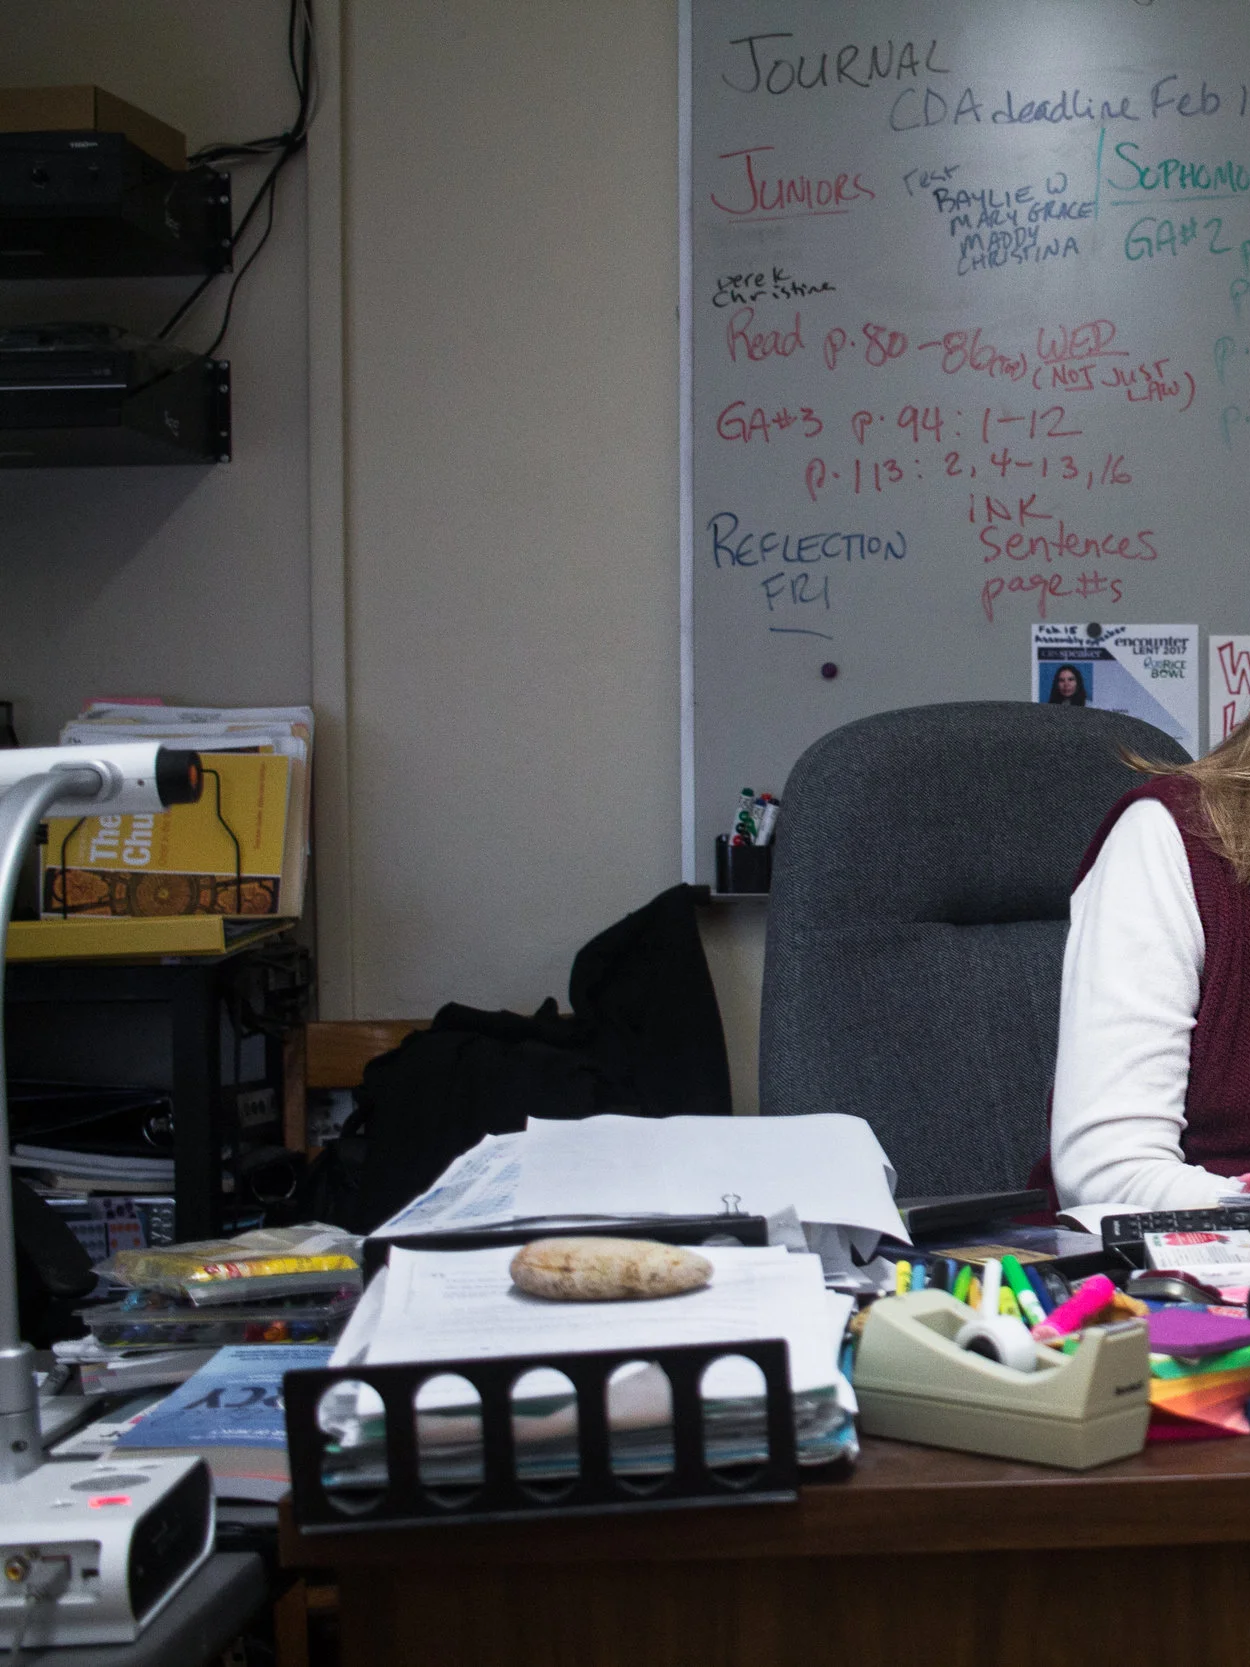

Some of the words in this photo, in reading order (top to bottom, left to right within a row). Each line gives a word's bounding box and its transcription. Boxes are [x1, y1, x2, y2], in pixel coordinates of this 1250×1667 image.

[721, 33, 950, 95] JOURNAL
[890, 86, 984, 131] CDA
[991, 90, 1139, 124] deadline
[1151, 75, 1222, 118] Feb
[710, 146, 876, 216] JUNIORS
[932, 186, 1035, 213] BAYLIE
[951, 209, 1019, 237] MARY
[1028, 201, 1094, 223] GRACE
[957, 236, 1080, 276] CHRISTINA
[960, 225, 1041, 258] MADDY
[726, 308, 805, 362] Read
[708, 511, 908, 569] REFLECTION
[761, 571, 831, 612] FRI
[982, 572, 1074, 622] page
[1114, 636, 1190, 647] encounter
[1132, 647, 1160, 656] LENT
[1163, 647, 1188, 656] 2017
[1151, 669, 1186, 679] BOWL
[123, 813, 155, 866] Chu
